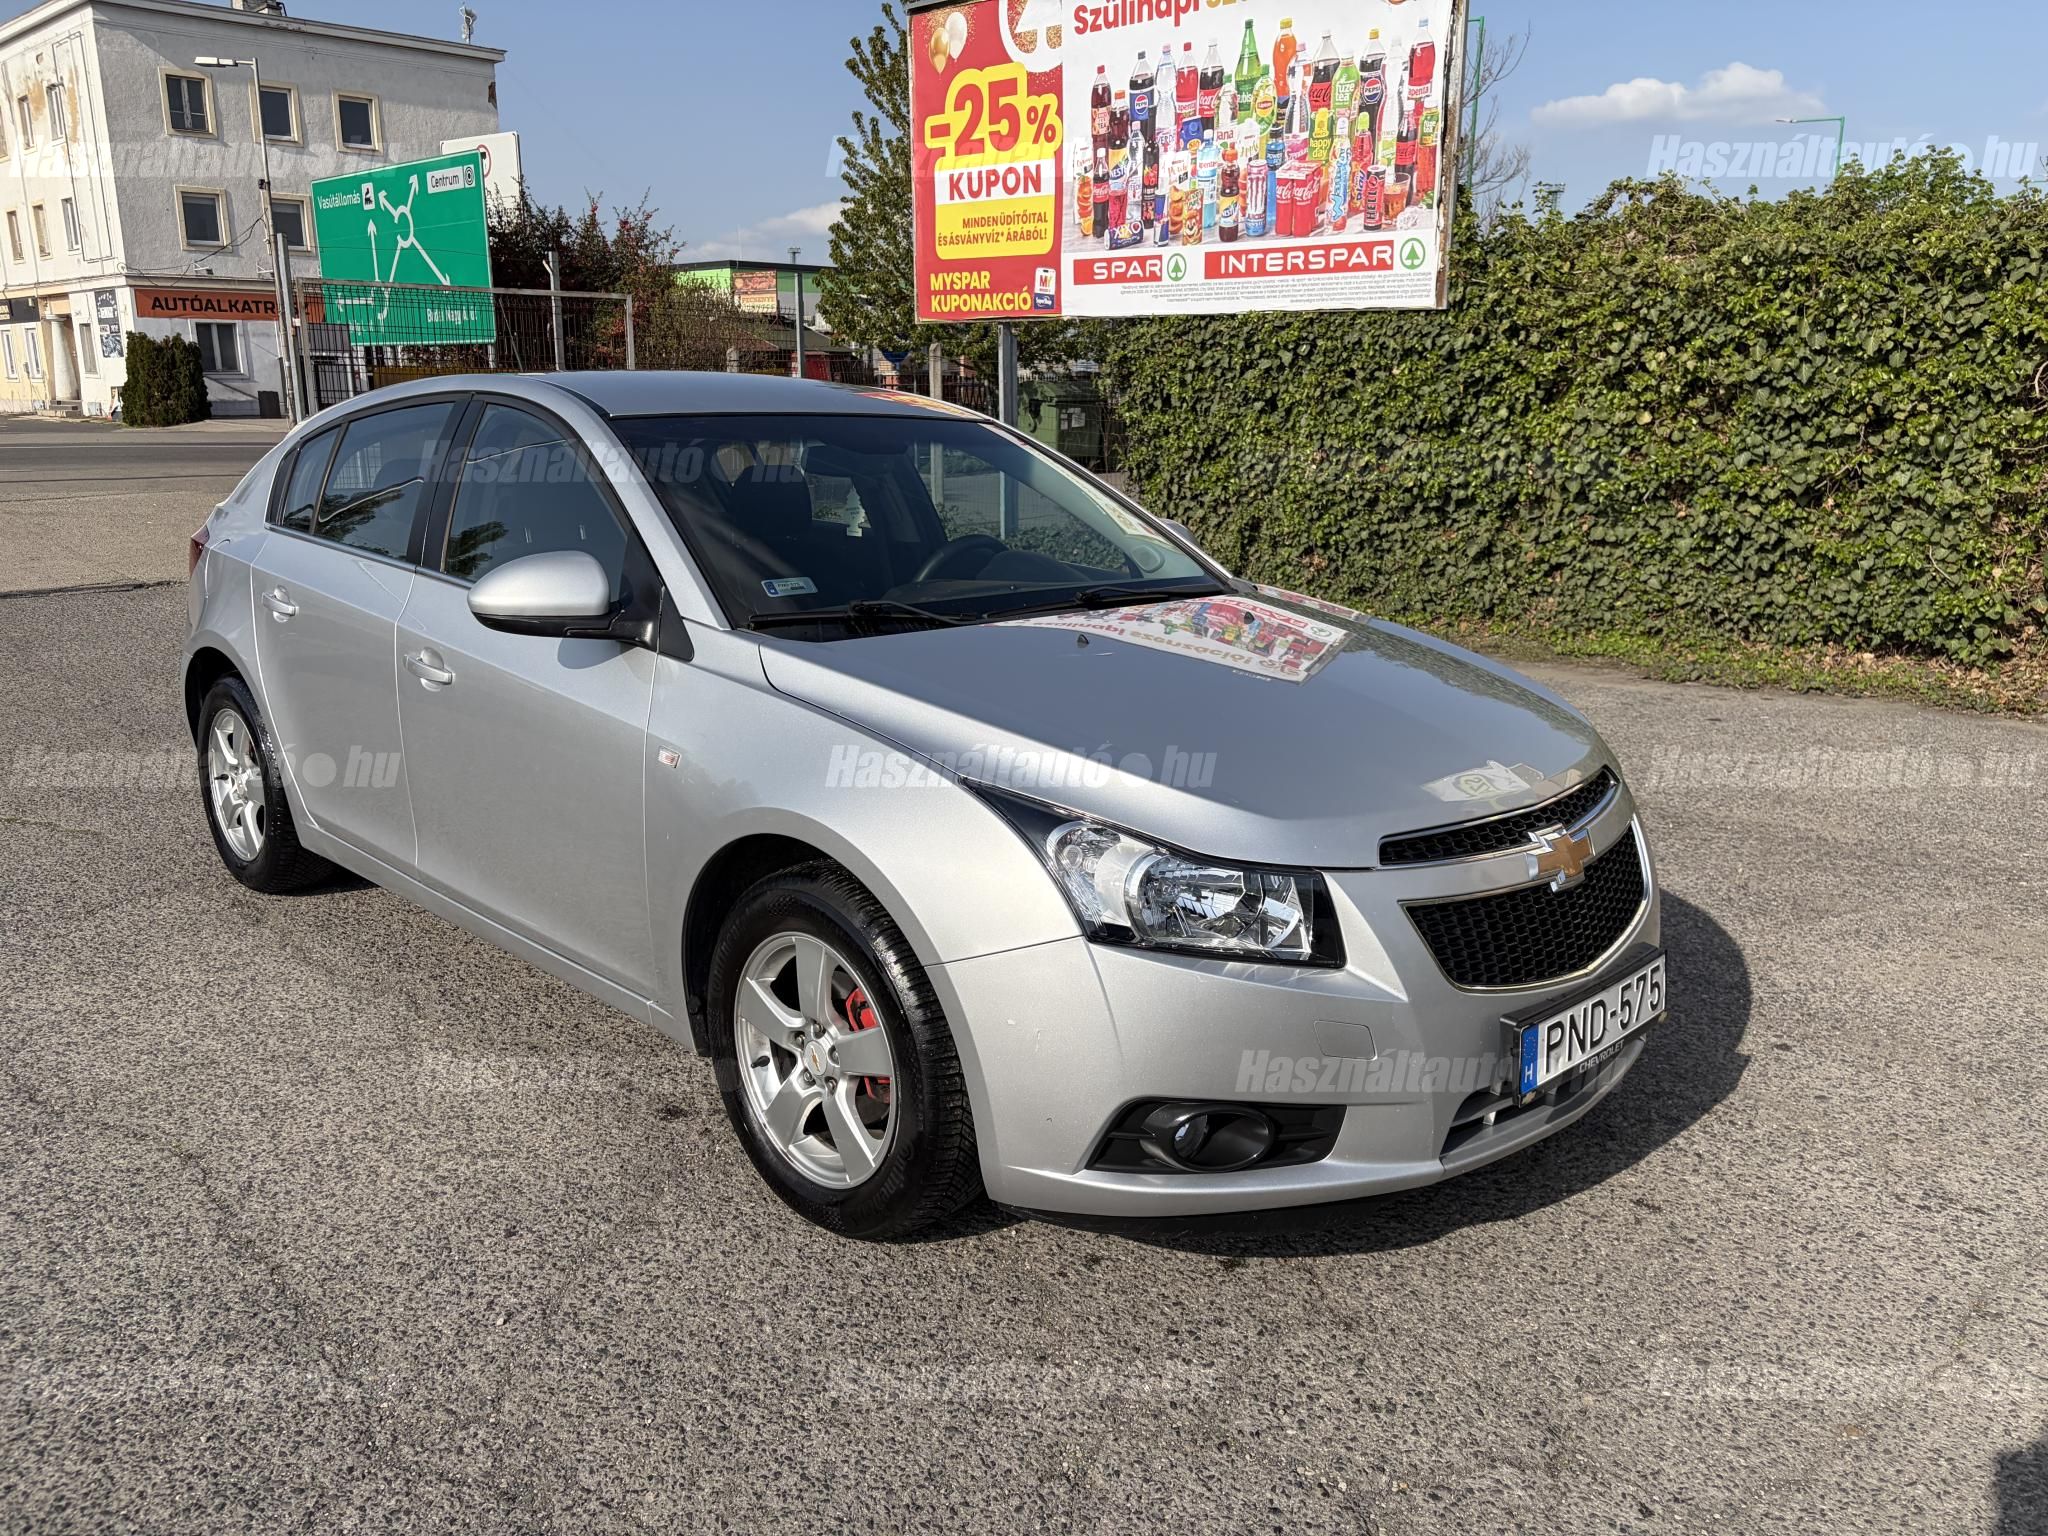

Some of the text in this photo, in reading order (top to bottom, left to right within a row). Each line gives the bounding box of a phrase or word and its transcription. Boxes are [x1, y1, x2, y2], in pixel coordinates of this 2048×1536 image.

[430, 173, 460, 189] Centrum
[949, 164, 1042, 200] KUPON
[317, 191, 361, 210] Vasútállomás
[962, 212, 1048, 229] MINDEN ÜDÍTŐITAL
[938, 232, 948, 247] ÉS
[1006, 228, 1048, 243] ÁRÁBÓL!
[1093, 244, 1393, 281] SPAR INTERSPAR
[930, 271, 991, 291] MYSPAR
[151, 294, 310, 315] AUTÓALKATR
[931, 288, 1032, 313] KUPONAKCIÓ
[1524, 963, 1662, 1083] H PND-575
[1579, 1040, 1625, 1074] CHEVROLET
